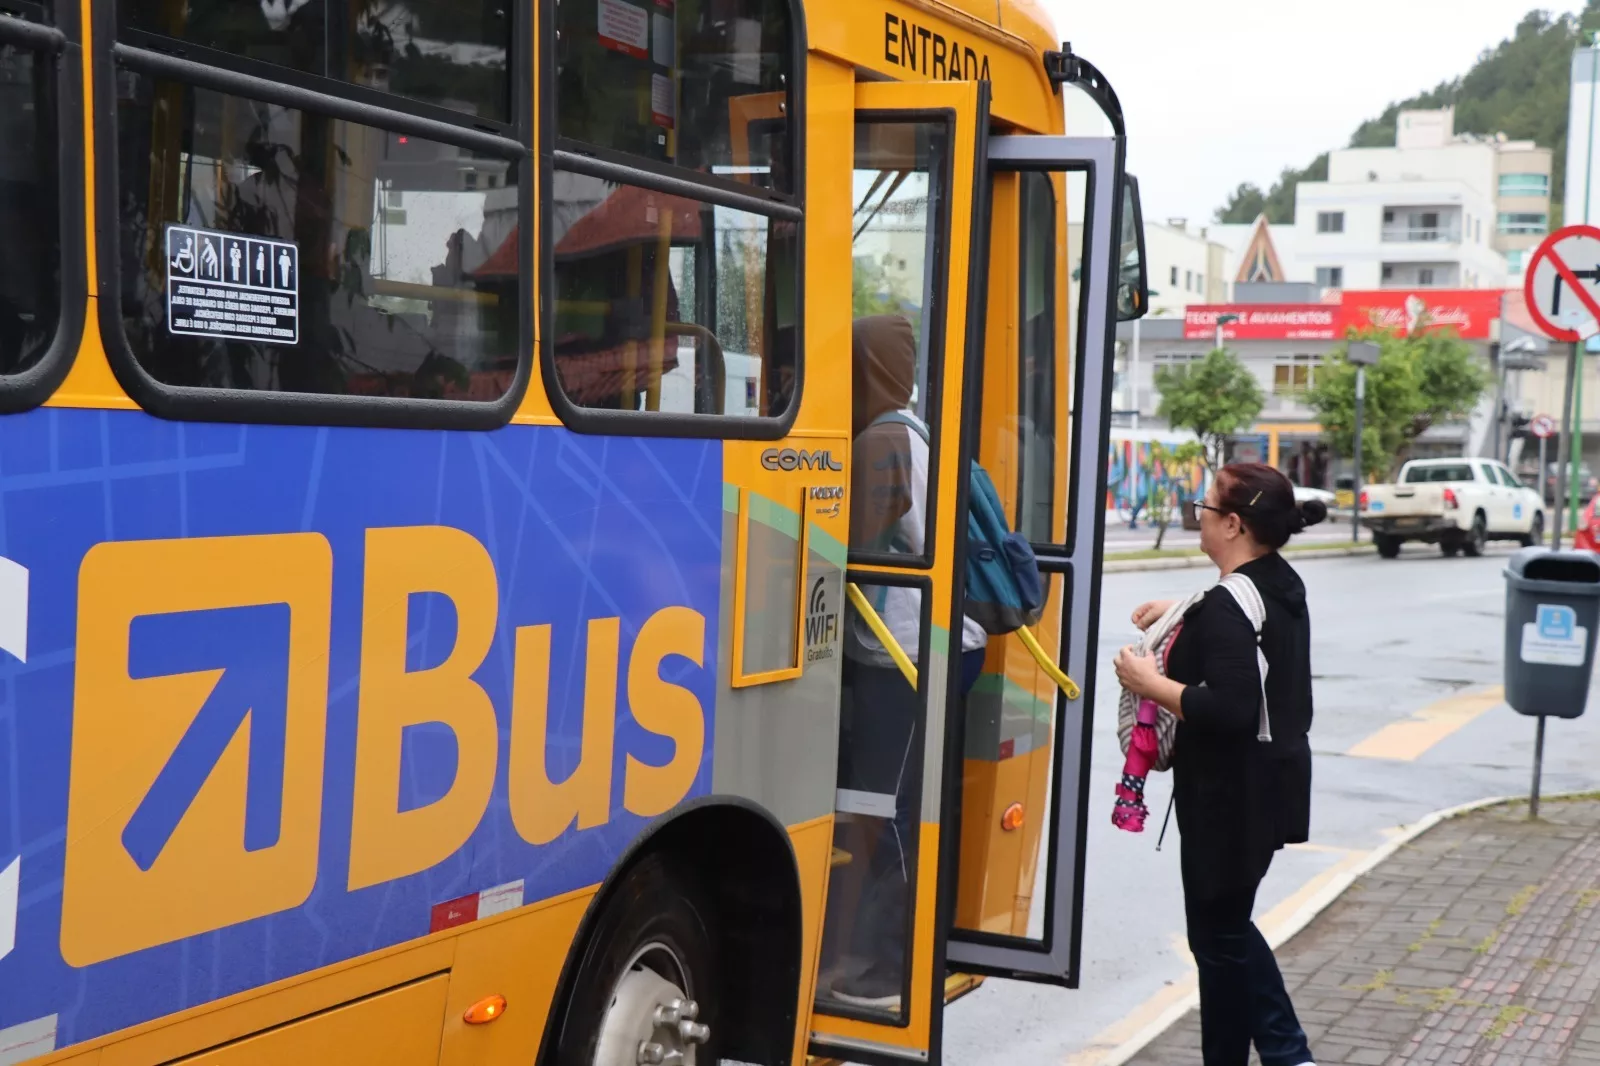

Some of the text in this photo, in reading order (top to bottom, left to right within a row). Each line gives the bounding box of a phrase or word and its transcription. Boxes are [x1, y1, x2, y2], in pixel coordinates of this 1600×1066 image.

[761, 448, 843, 471] COMIL
[805, 614, 838, 646] WIFI
[347, 525, 706, 892] Bus
